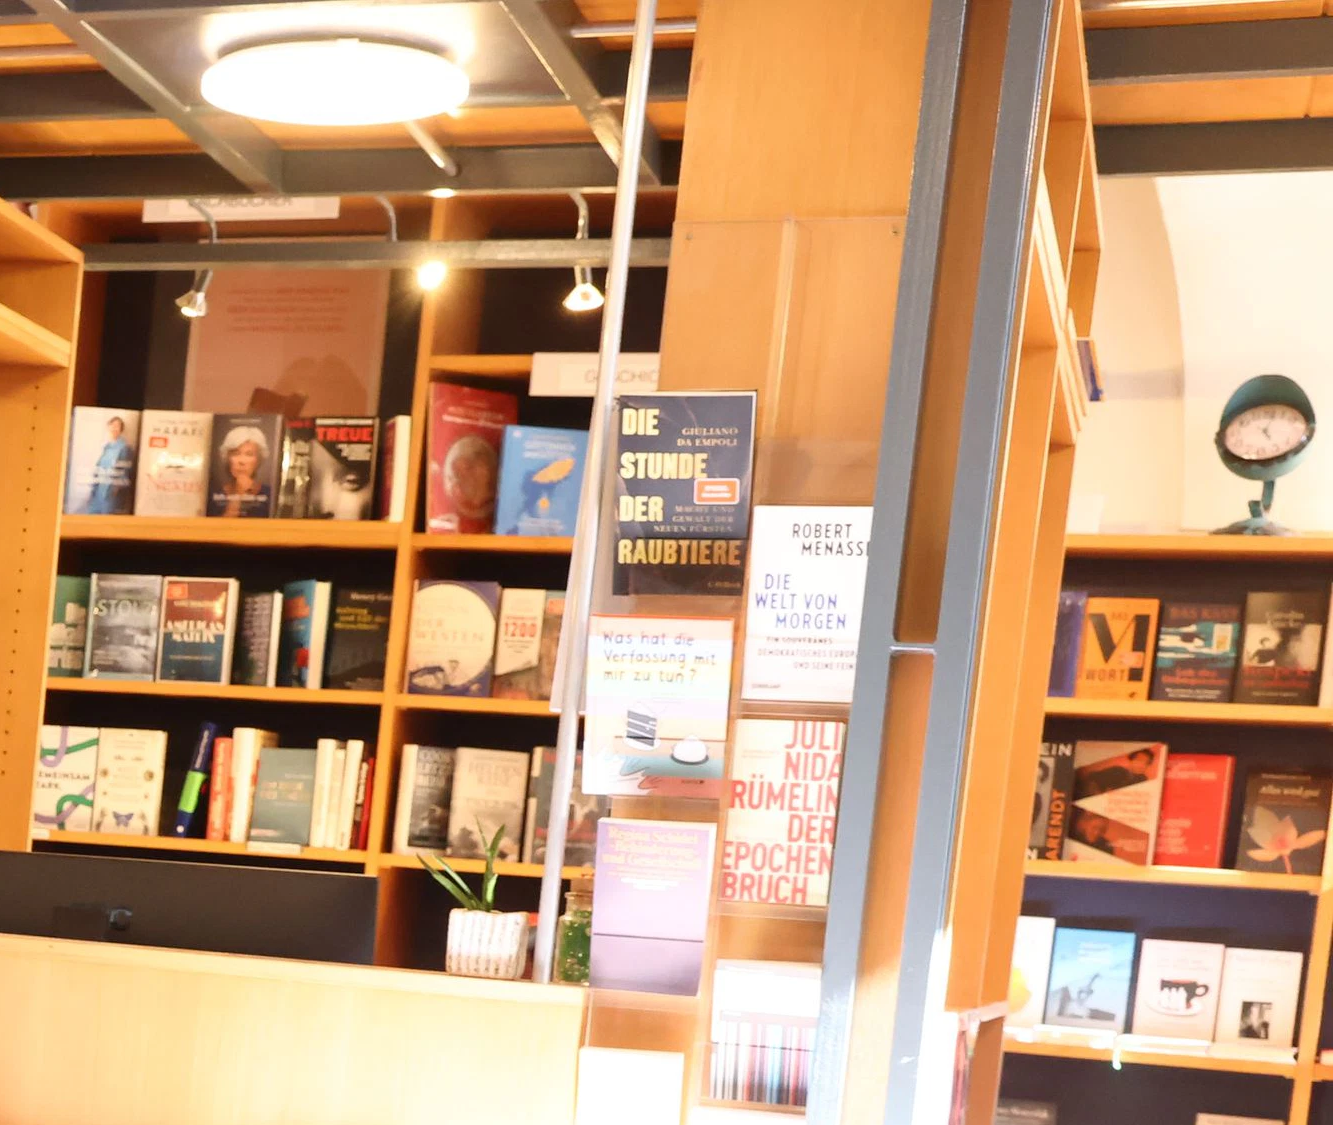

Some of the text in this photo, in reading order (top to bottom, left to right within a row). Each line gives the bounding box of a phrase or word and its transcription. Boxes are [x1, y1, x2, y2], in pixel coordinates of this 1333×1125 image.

[622, 408, 660, 436] DIE
[681, 427, 739, 436] GIULIANO
[316, 427, 373, 442] TREUE
[677, 438, 737, 447] DA EMPOLI
[619, 452, 708, 480] STUNDE
[619, 495, 664, 522] DER
[792, 523, 852, 539] ROBERT
[618, 539, 742, 565] RAUBTIERE
[764, 573, 792, 590] DIE
[755, 592, 838, 610] WELT VON
[775, 613, 847, 630] MORGEN
[603, 630, 694, 646] Was hat die
[603, 650, 717, 670] Verfassung mit
[603, 670, 650, 682] mir zu
[784, 752, 842, 781] NIDA
[729, 774, 838, 812] RÜMELIN
[787, 814, 837, 843] DER
[1045, 790, 1066, 861] ARENDT
[722, 840, 833, 875] EPOCHEN
[721, 871, 809, 905] BRUCH
